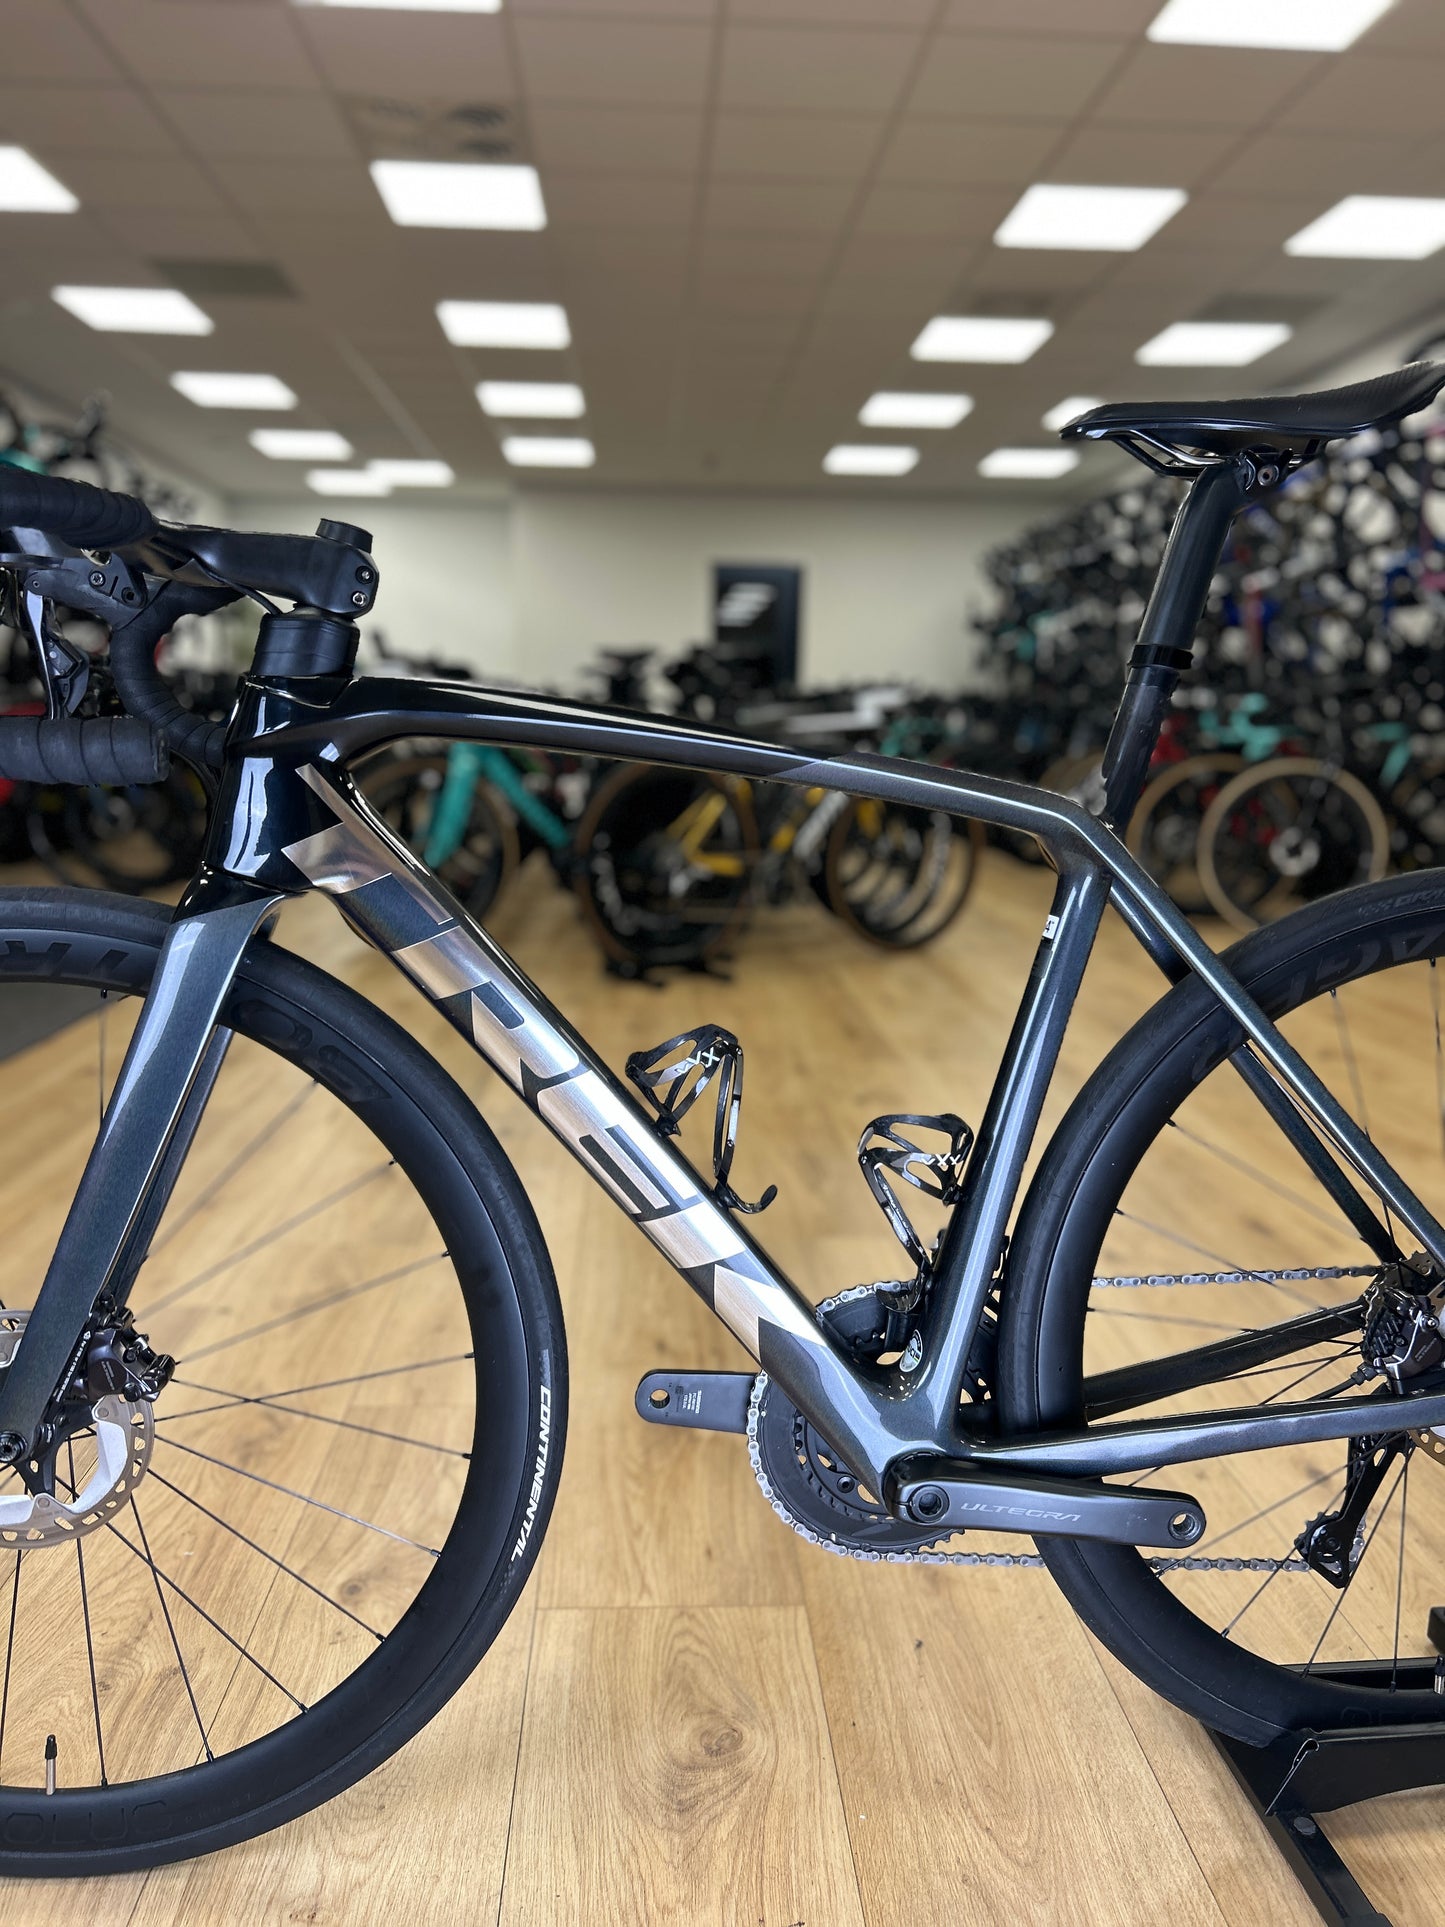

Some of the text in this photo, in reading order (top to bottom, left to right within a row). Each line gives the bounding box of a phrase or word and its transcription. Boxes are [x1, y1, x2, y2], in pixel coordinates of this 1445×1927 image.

[281, 764, 828, 1363] TREK
[510, 1384, 552, 1562] CONTINENTAL
[960, 1502, 1081, 1522] ULTEGRA
